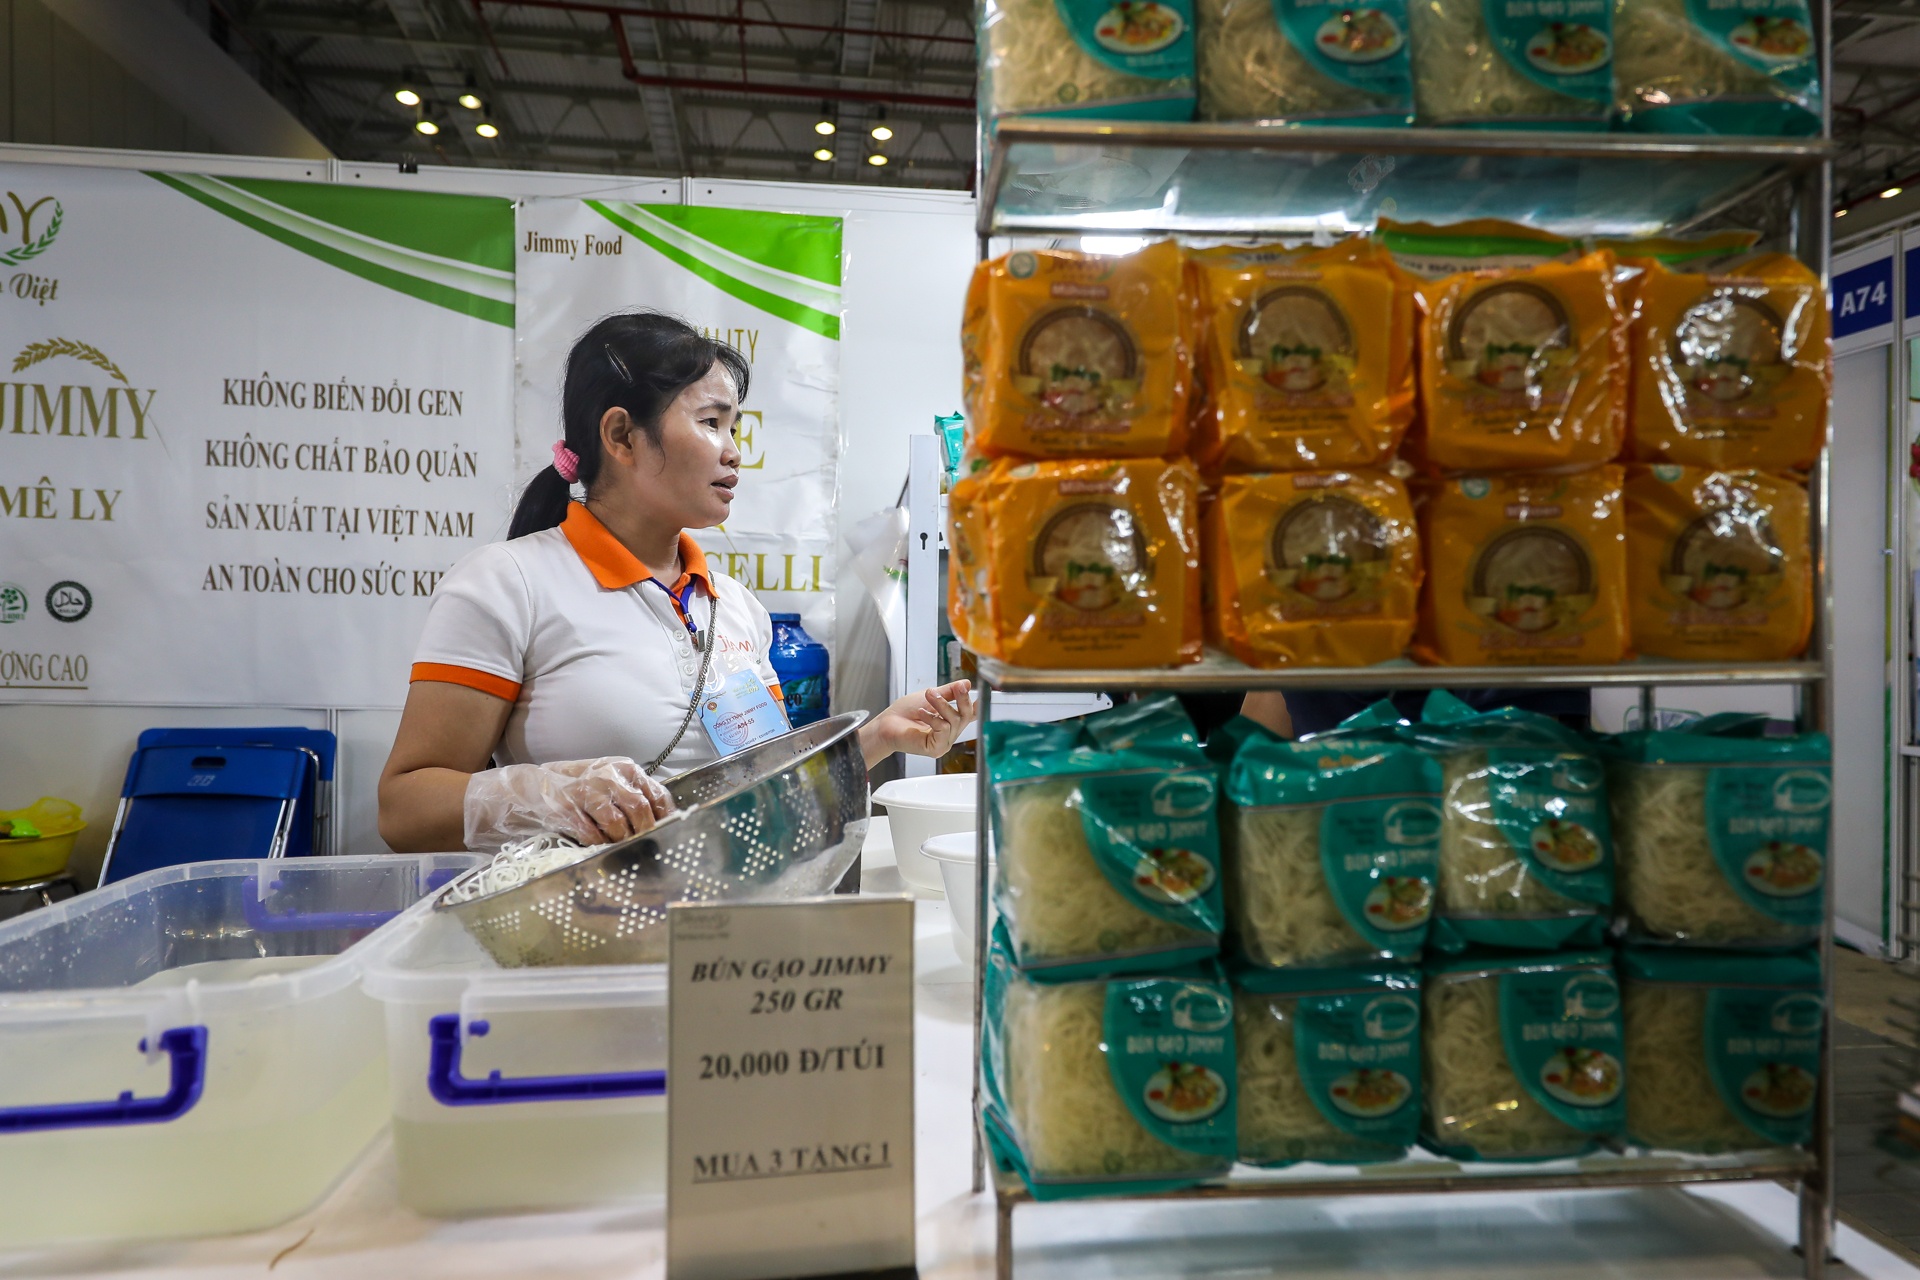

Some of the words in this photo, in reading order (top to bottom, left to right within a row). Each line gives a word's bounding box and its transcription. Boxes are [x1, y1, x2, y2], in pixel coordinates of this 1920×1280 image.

[524, 231, 578, 261] Jimmy
[584, 234, 622, 256] Food
[9, 273, 59, 306] Việt
[1840, 281, 1887, 317] A74
[223, 371, 307, 409] KHÔNG
[313, 376, 365, 411] BIẾN
[371, 379, 412, 414] ĐỔI
[418, 389, 463, 416] GEN
[205, 432, 289, 469] KHÔNG
[295, 437, 358, 472] CHẤT
[364, 440, 410, 475] BẢO
[416, 443, 477, 482] QUẢN
[70, 488, 122, 521] LY
[206, 494, 249, 529] SẢN
[255, 497, 317, 532] XUẤT
[322, 506, 359, 540] TẠI
[366, 504, 419, 542] VIỆT
[424, 510, 474, 538] NAM
[202, 564, 234, 591] AN
[239, 557, 301, 592] TOÀN
[307, 567, 356, 595] CHO
[361, 561, 406, 596] SỨC
[0, 650, 43, 686] ỢNG
[48, 654, 88, 682] CAO
[691, 955, 747, 983] BÚN
[751, 958, 805, 984] GẠO
[809, 954, 893, 978] JIMMY
[750, 989, 796, 1015] 250
[803, 987, 844, 1012] GR
[699, 1051, 790, 1083] 20,000
[798, 1037, 886, 1074] Đ/TÚI
[693, 1152, 760, 1178] MUA
[769, 1149, 782, 1172] 3
[881, 1141, 890, 1163] 1
